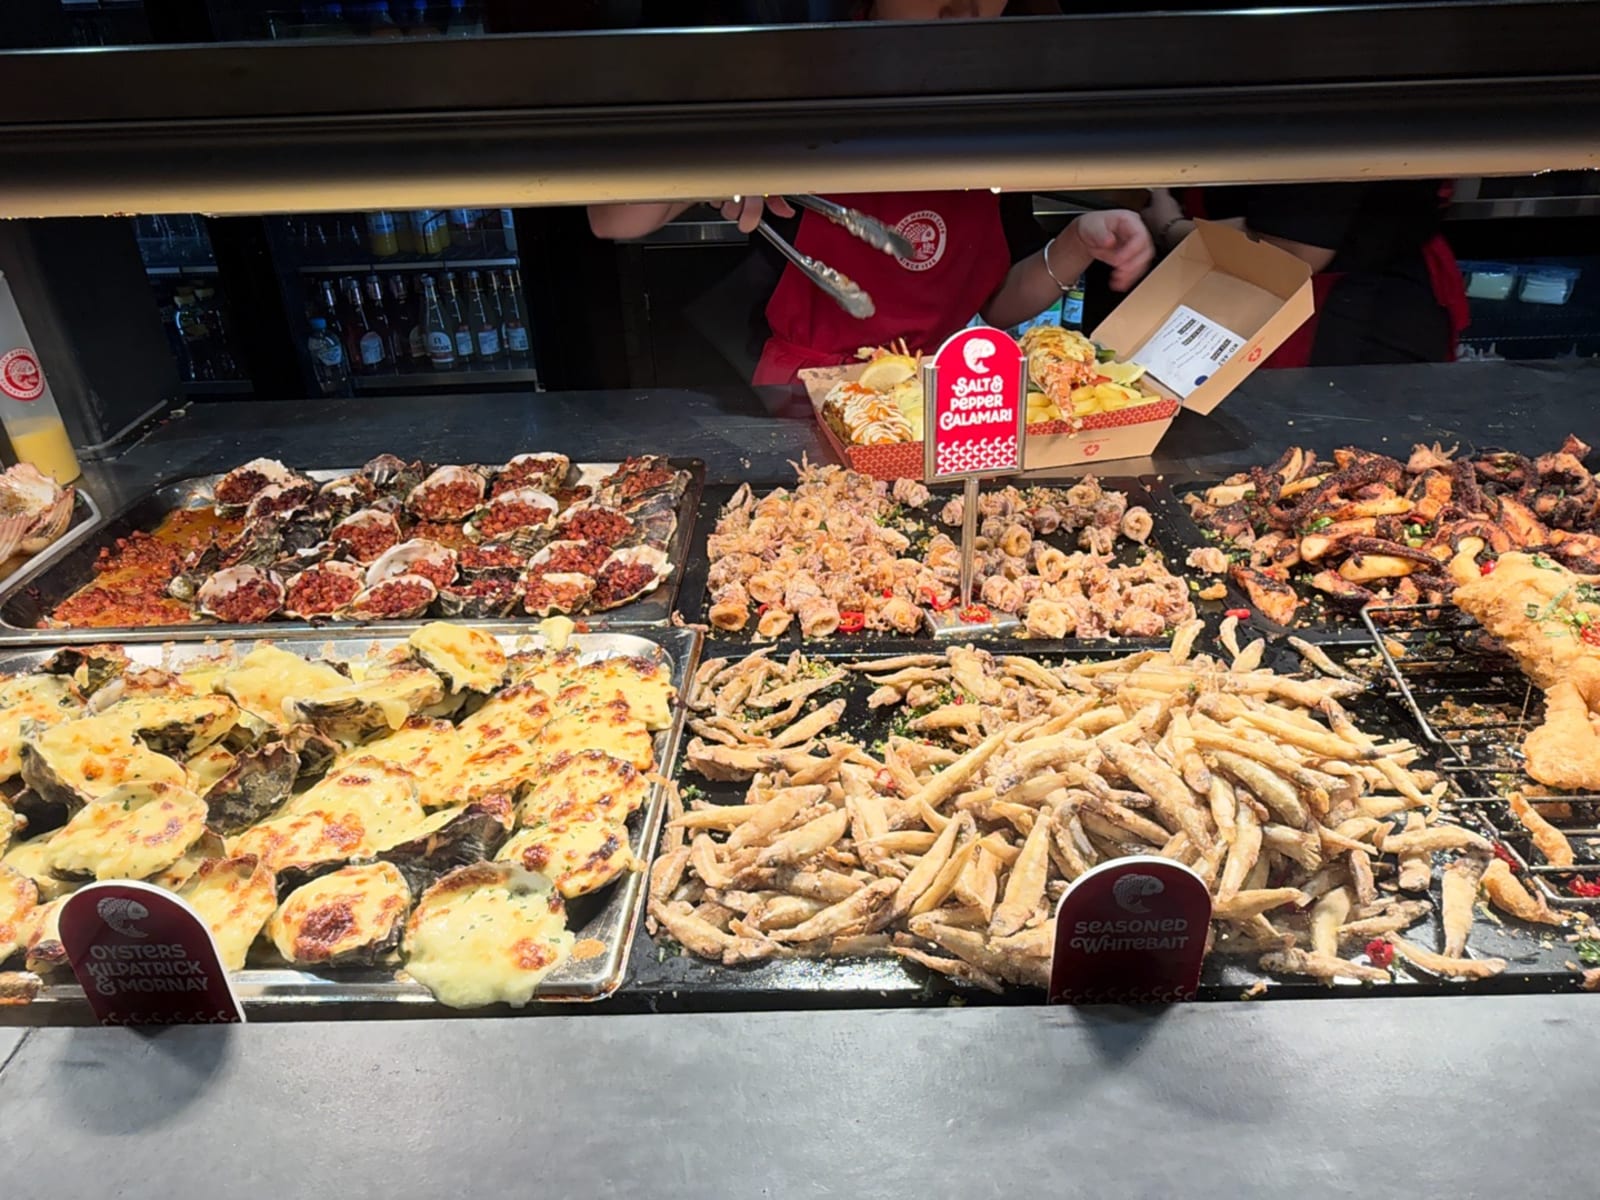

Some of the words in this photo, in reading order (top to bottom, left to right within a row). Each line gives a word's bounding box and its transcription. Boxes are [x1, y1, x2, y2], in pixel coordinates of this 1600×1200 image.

[950, 394, 1004, 411] PEPPER
[940, 408, 1013, 431] CALAMARI
[1074, 919, 1188, 934] SEASONED
[90, 944, 187, 960] OYSTERS
[1069, 934, 1189, 954] WHITEBAIT
[85, 960, 205, 978] KILPATRICK
[96, 974, 117, 996] &
[119, 977, 209, 993] MORNAY
